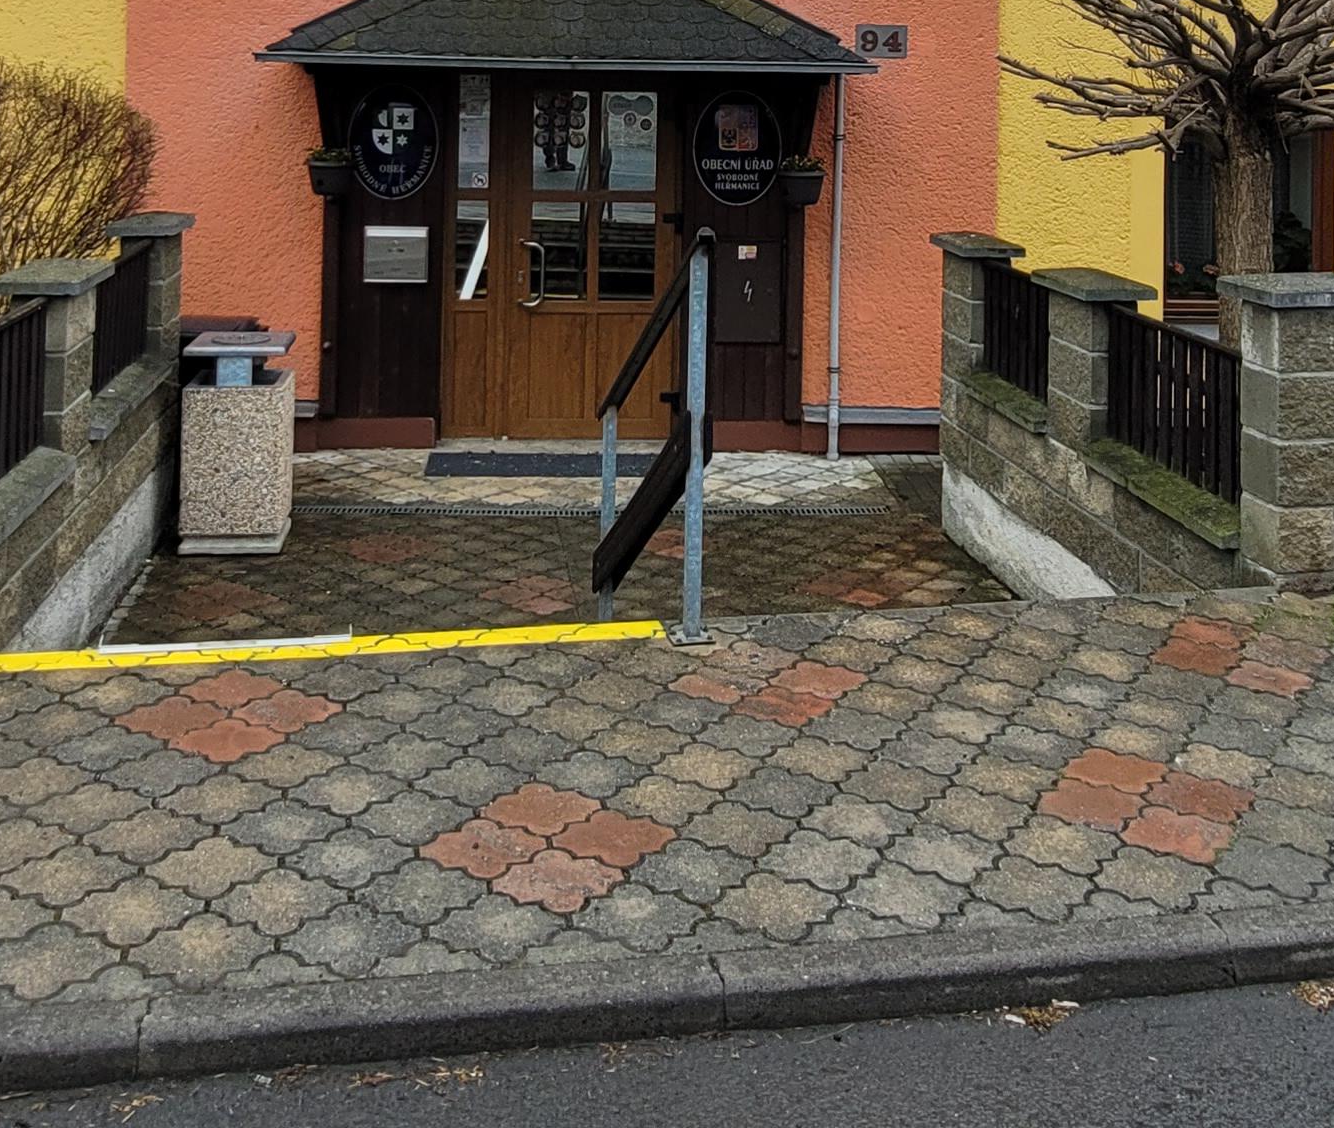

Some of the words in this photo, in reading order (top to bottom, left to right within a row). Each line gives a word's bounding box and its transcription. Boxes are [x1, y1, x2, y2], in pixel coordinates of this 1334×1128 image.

[860, 30, 902, 52] 94
[379, 164, 406, 173] OBEC
[701, 157, 741, 170] OBECNÍ
[744, 156, 774, 170] ÚŘAD
[717, 173, 758, 181] SVOBODNÉ
